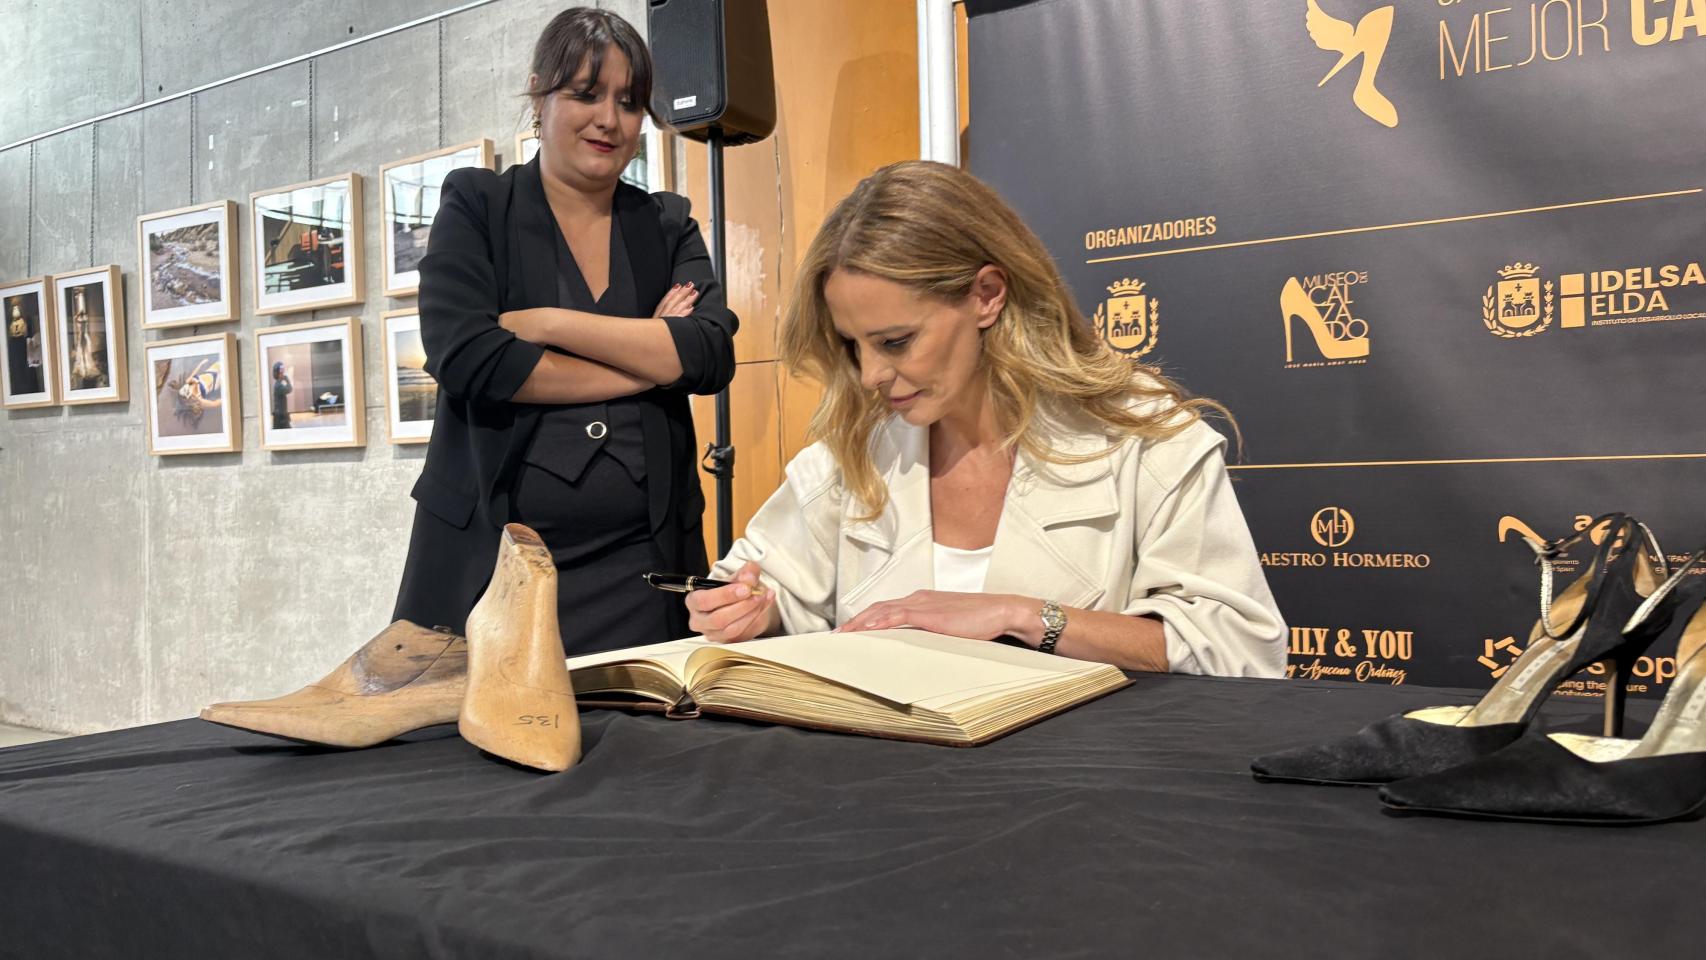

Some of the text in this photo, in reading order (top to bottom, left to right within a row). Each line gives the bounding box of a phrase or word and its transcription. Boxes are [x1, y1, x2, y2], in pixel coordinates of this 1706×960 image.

[1439, 0, 1611, 80] MEJOR
[1085, 215, 1217, 250] ORGANIZADORES
[1302, 270, 1359, 289] MUSEO
[1590, 262, 1706, 294] IDELSA
[1308, 281, 1354, 307] CAL
[1591, 289, 1669, 317] ELDA
[1324, 318, 1369, 341] DO
[1258, 552, 1431, 568] AESTRO HORMERO
[1334, 628, 1357, 658] &
[1361, 629, 1414, 661] YOU
